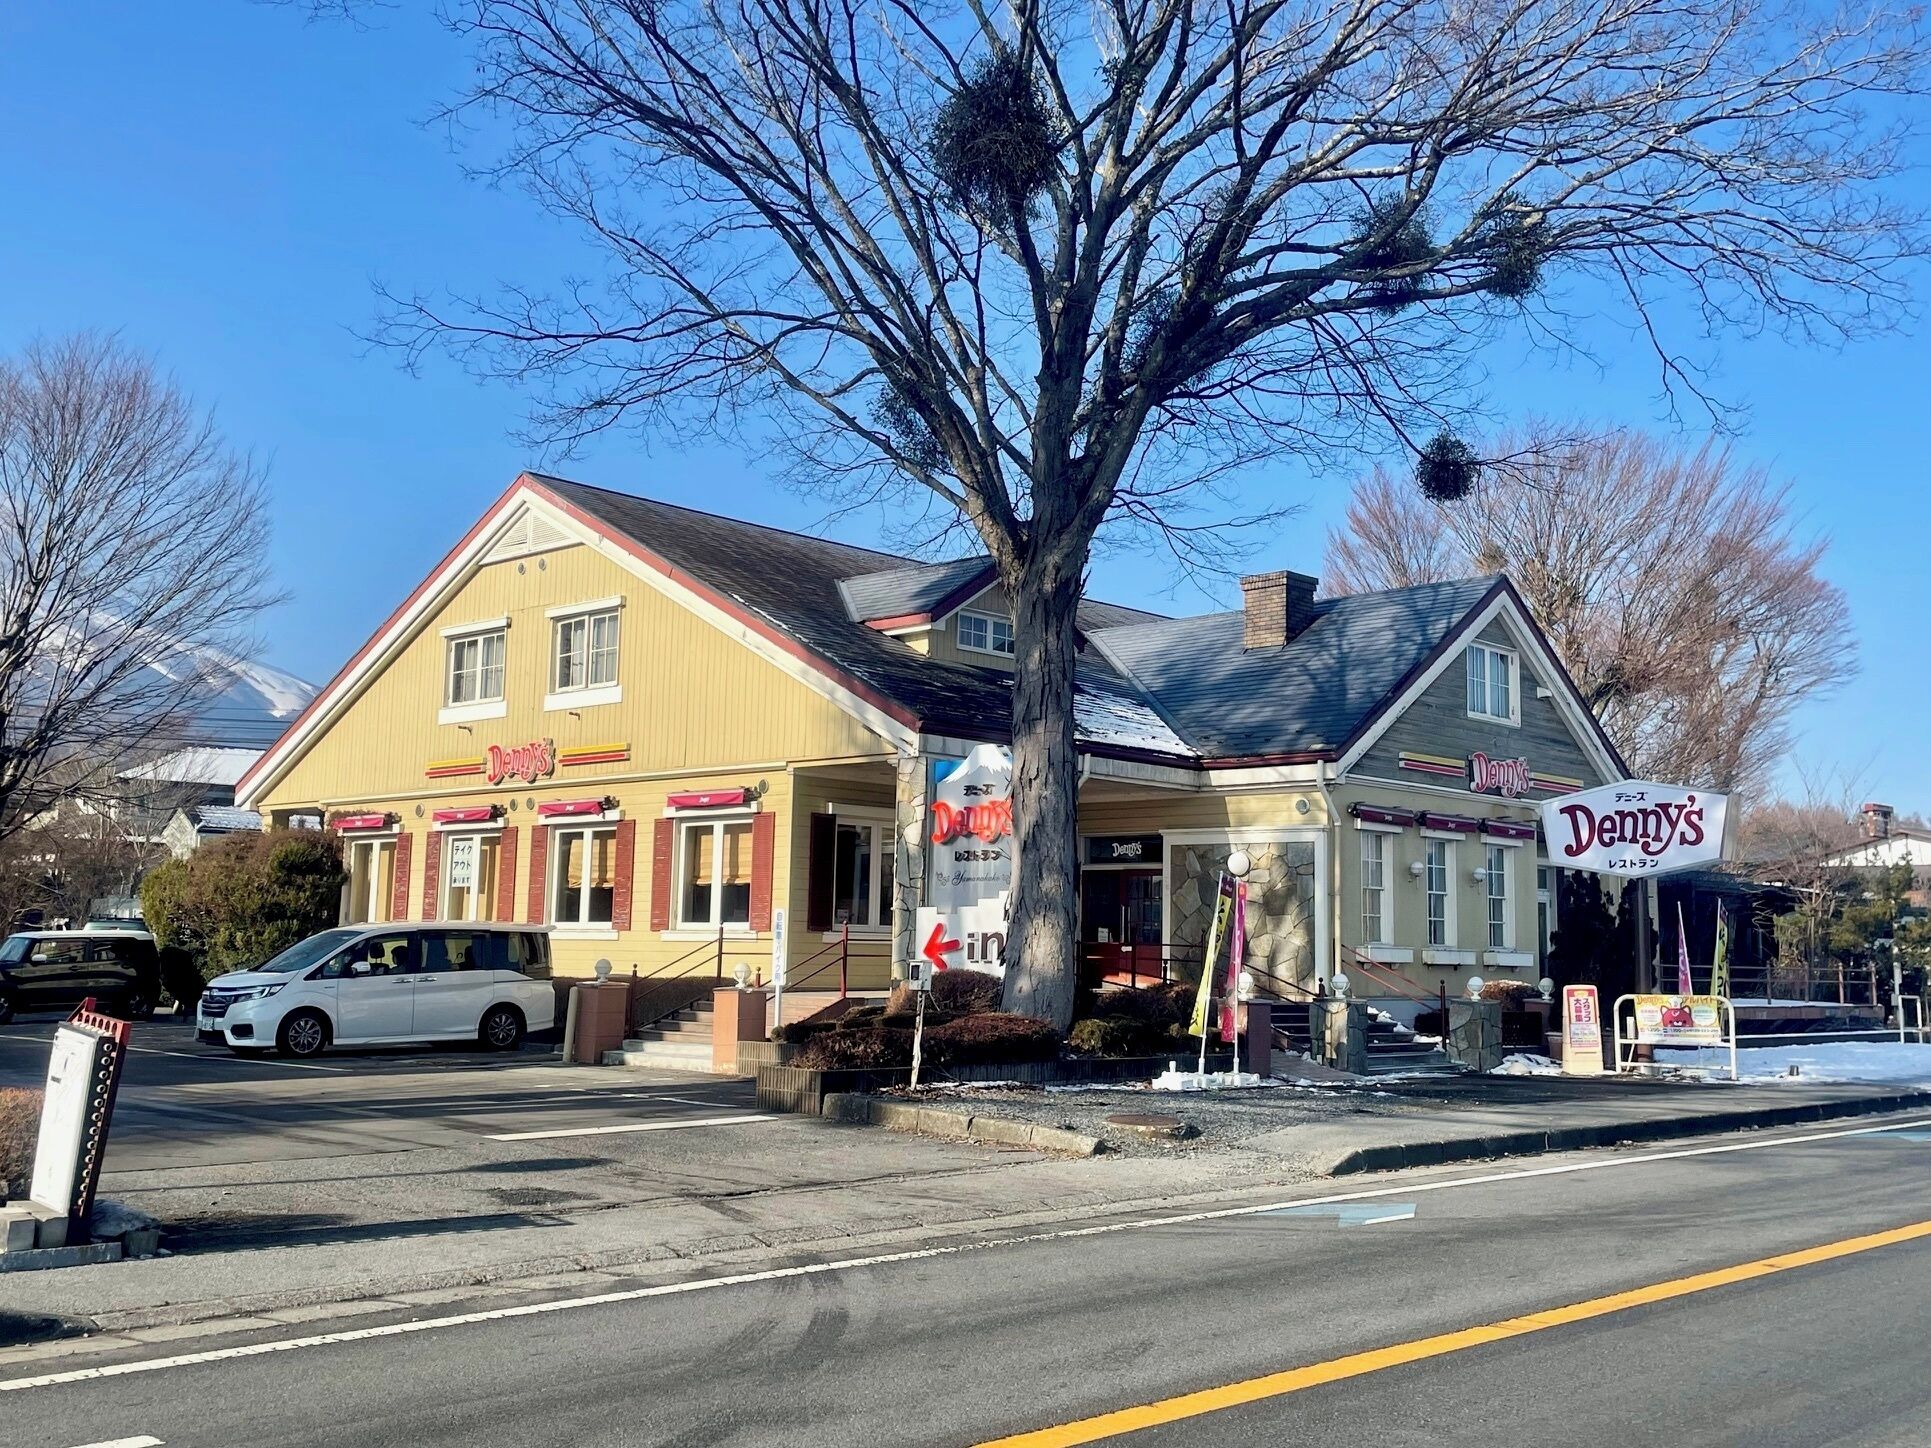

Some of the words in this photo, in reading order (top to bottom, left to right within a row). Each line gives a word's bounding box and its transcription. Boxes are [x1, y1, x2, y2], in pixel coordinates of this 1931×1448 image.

[487, 742, 551, 783] Denny's
[1470, 752, 1530, 798] Denny's
[1615, 792, 1648, 803] デニーズ
[1559, 794, 1705, 858] Denny's
[454, 845, 473, 855] テイク
[954, 850, 1001, 862] レストラン
[1112, 841, 1142, 857] Denny's
[453, 860, 472, 871] アウト
[1608, 858, 1659, 869] レストラン
[967, 931, 1005, 960] in
